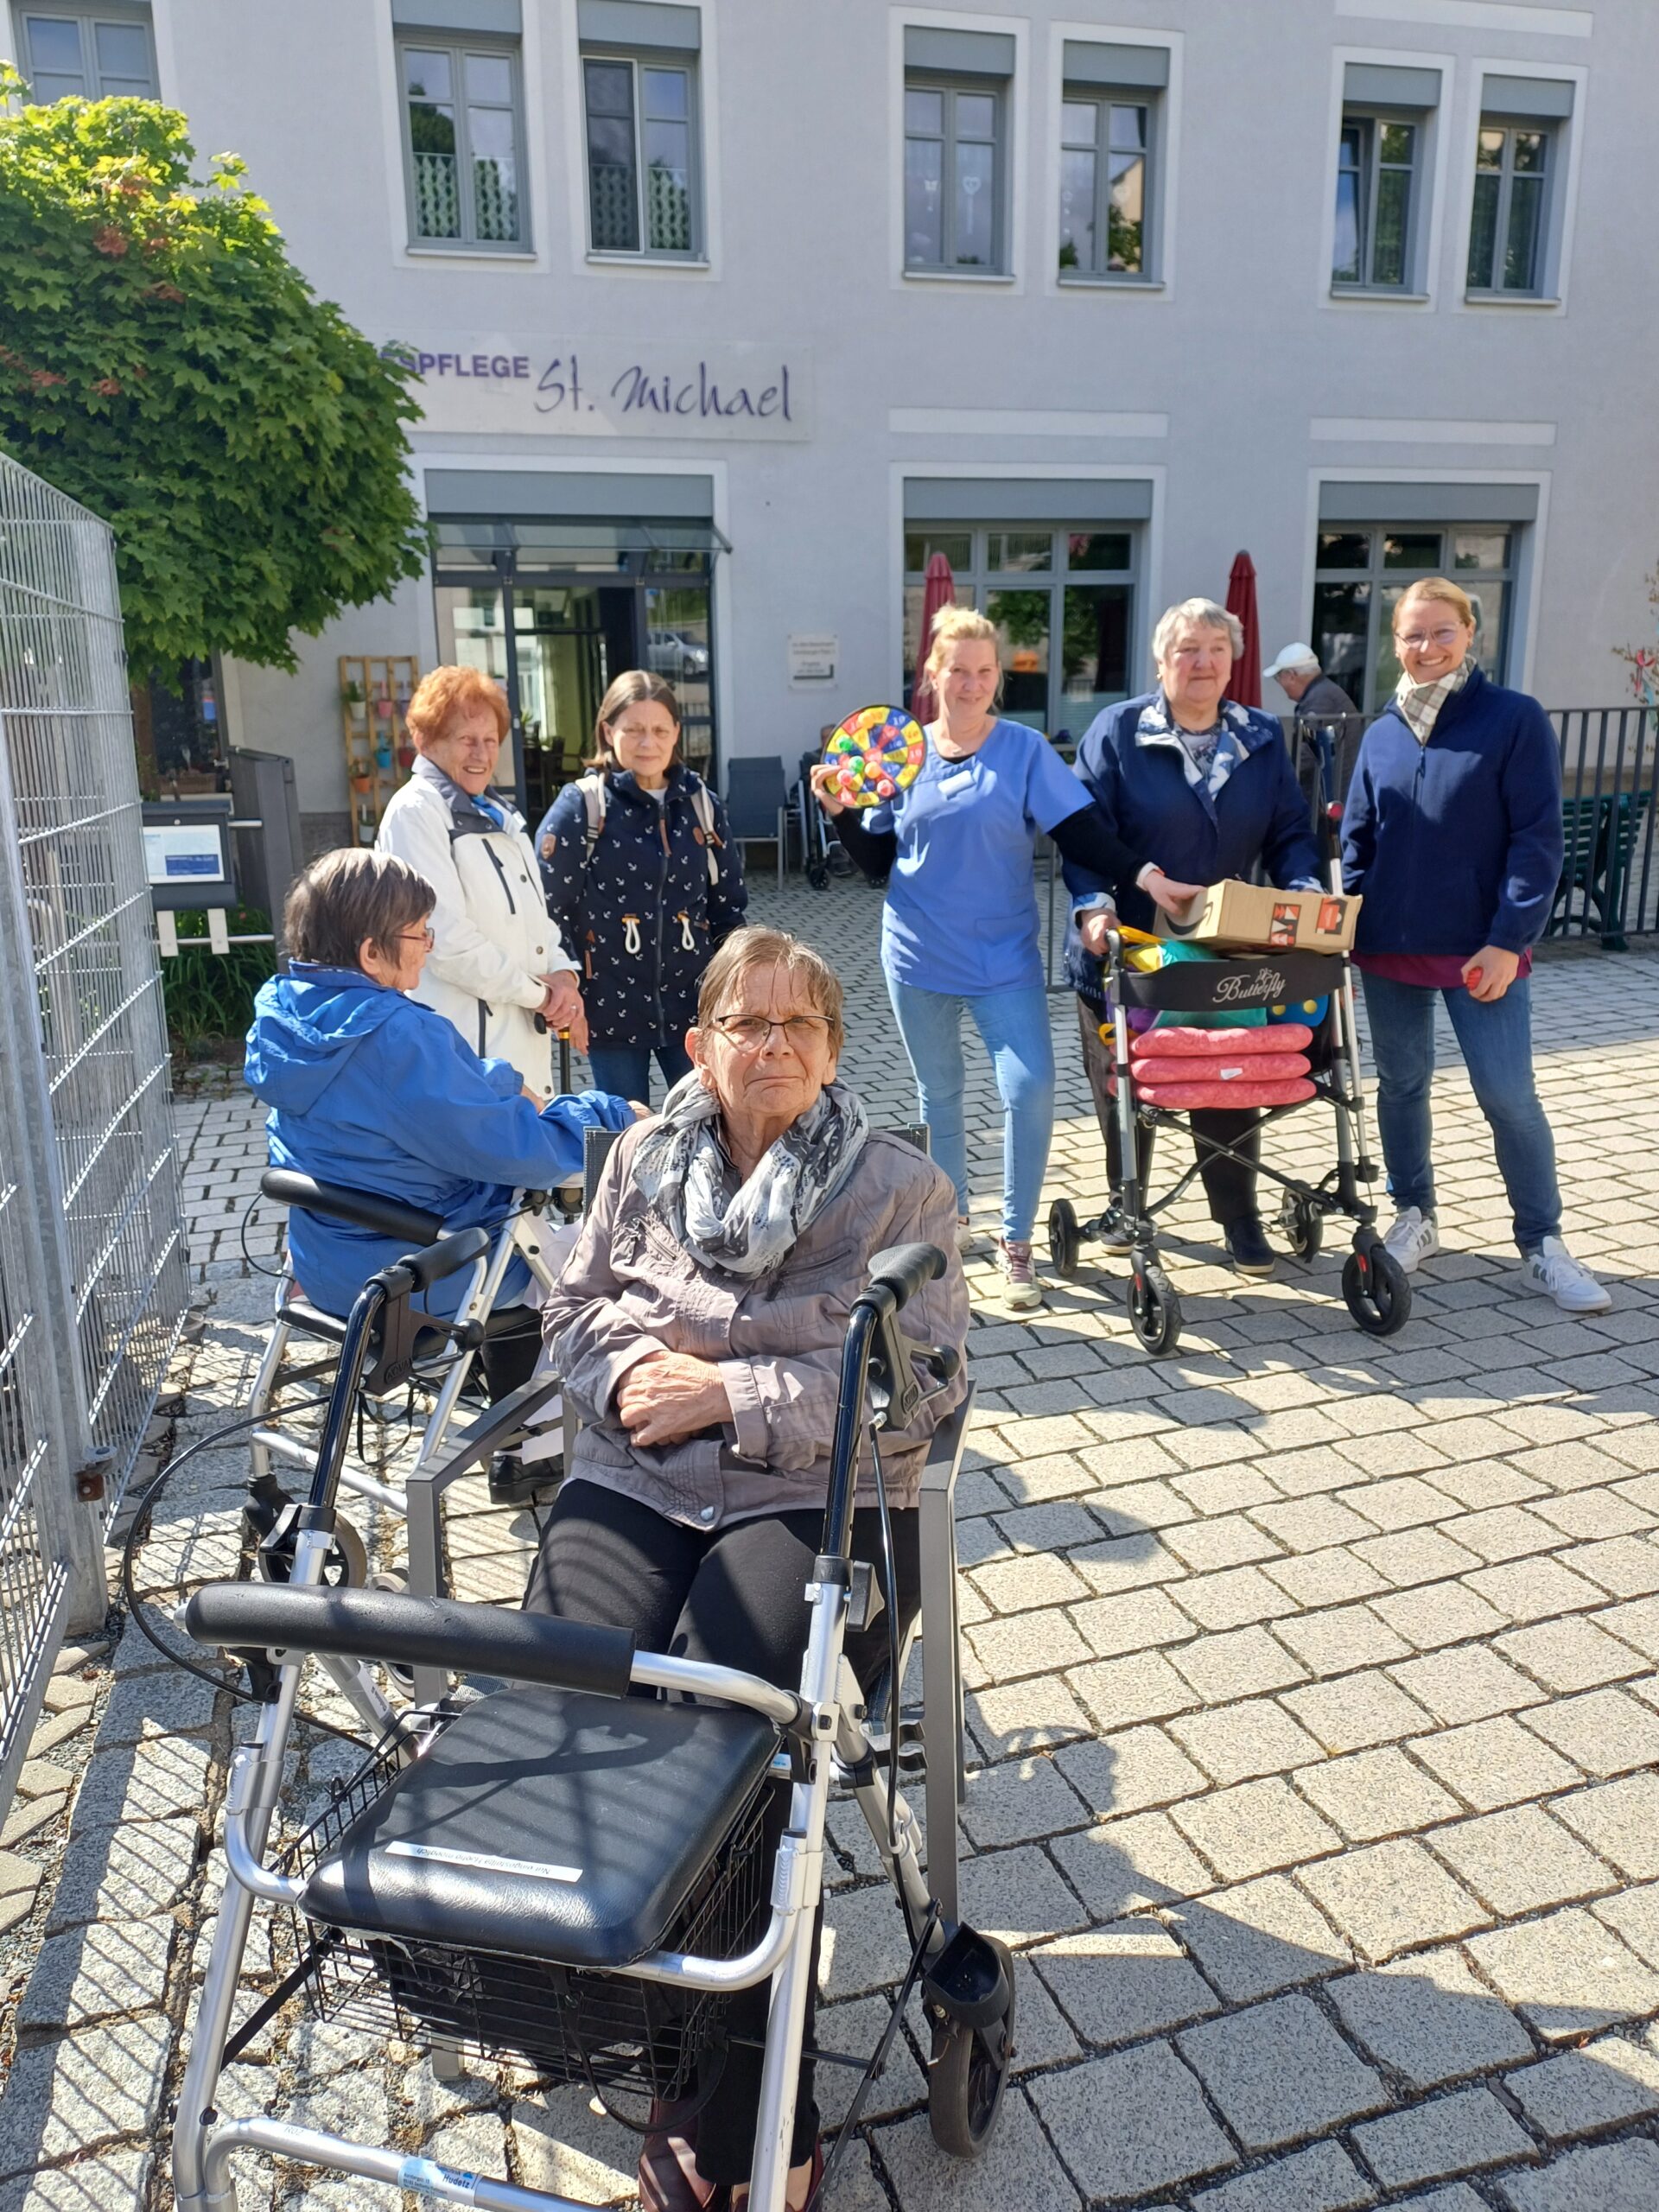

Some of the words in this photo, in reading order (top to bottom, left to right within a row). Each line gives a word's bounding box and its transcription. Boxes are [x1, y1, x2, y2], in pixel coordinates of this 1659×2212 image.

[534, 355, 594, 413] St.
[611, 362, 791, 421] Michael
[1212, 972, 1287, 1003] Butterfly
[442, 2173, 470, 2190] Hudetz
